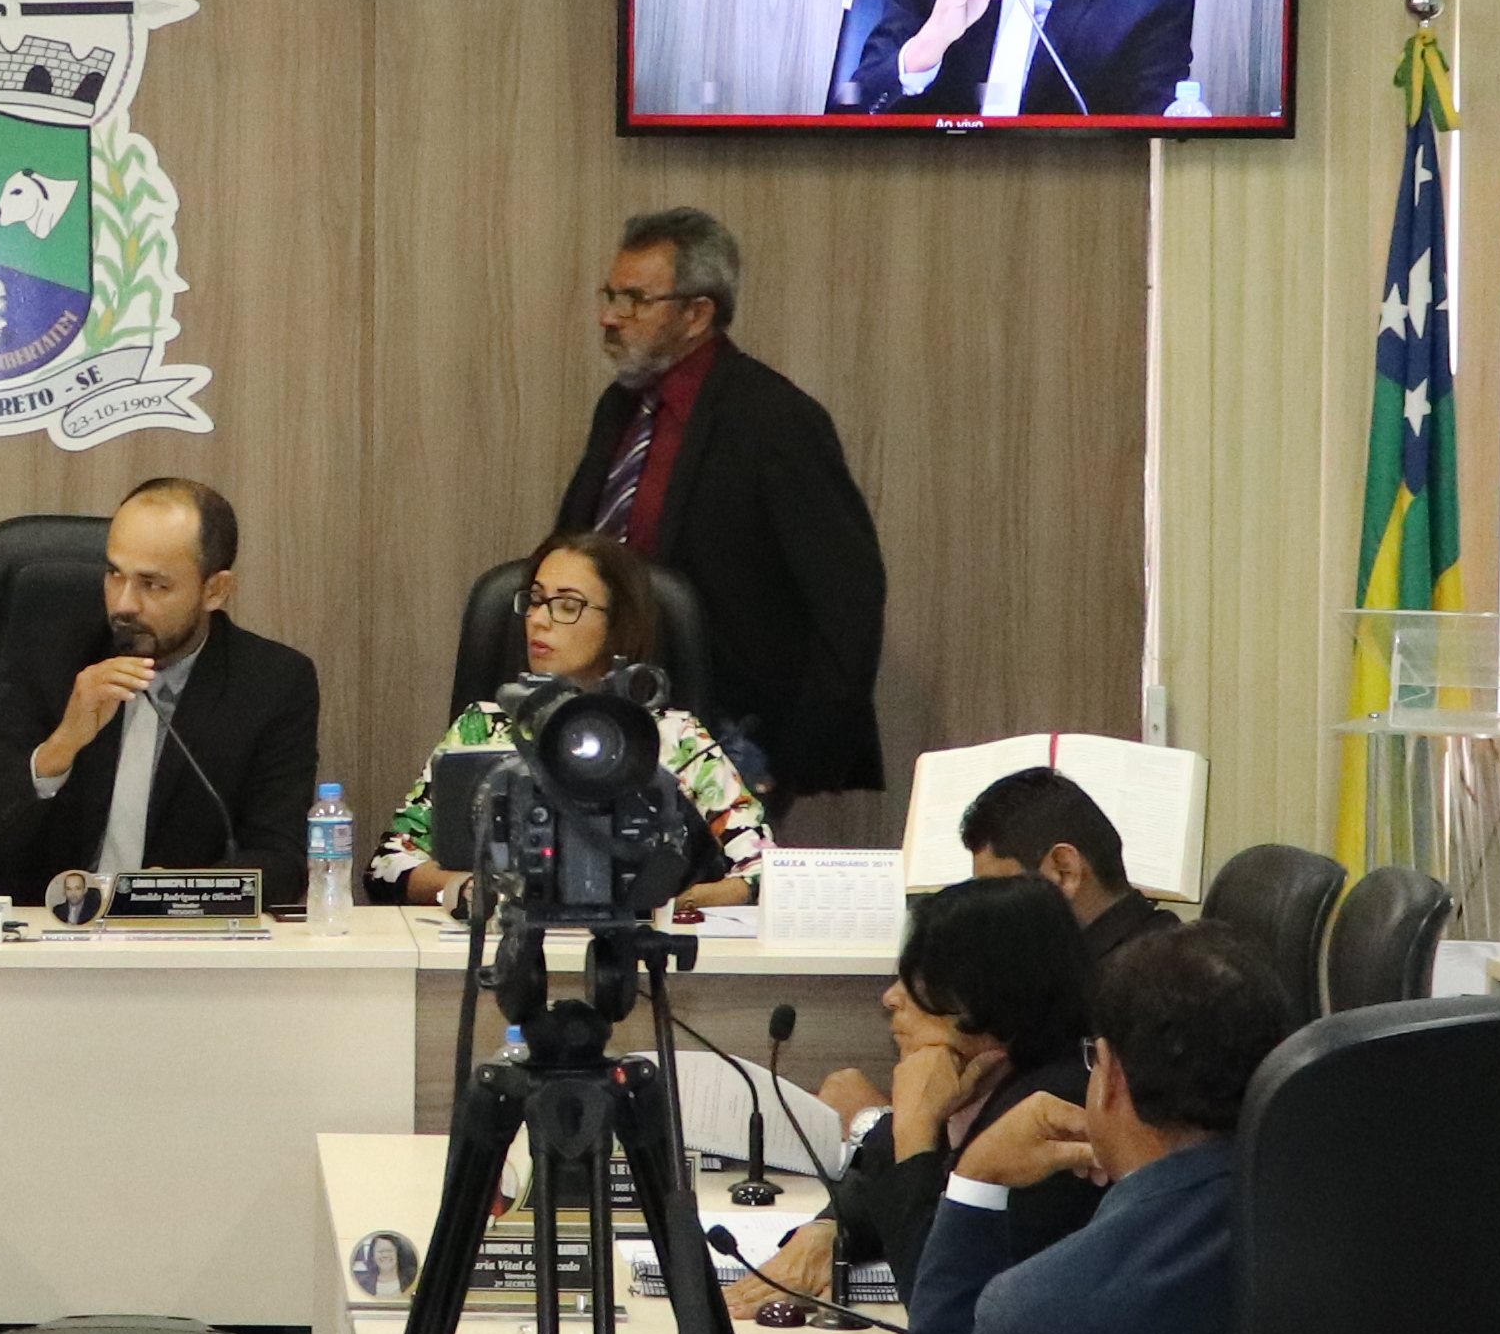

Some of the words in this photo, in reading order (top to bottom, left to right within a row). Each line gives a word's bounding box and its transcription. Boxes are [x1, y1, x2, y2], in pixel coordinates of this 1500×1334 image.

[75, 364, 104, 391] SE
[67, 395, 163, 435] 23-10-1909
[773, 859, 806, 867] CAIXA
[815, 859, 869, 868] CALENDÁRIO
